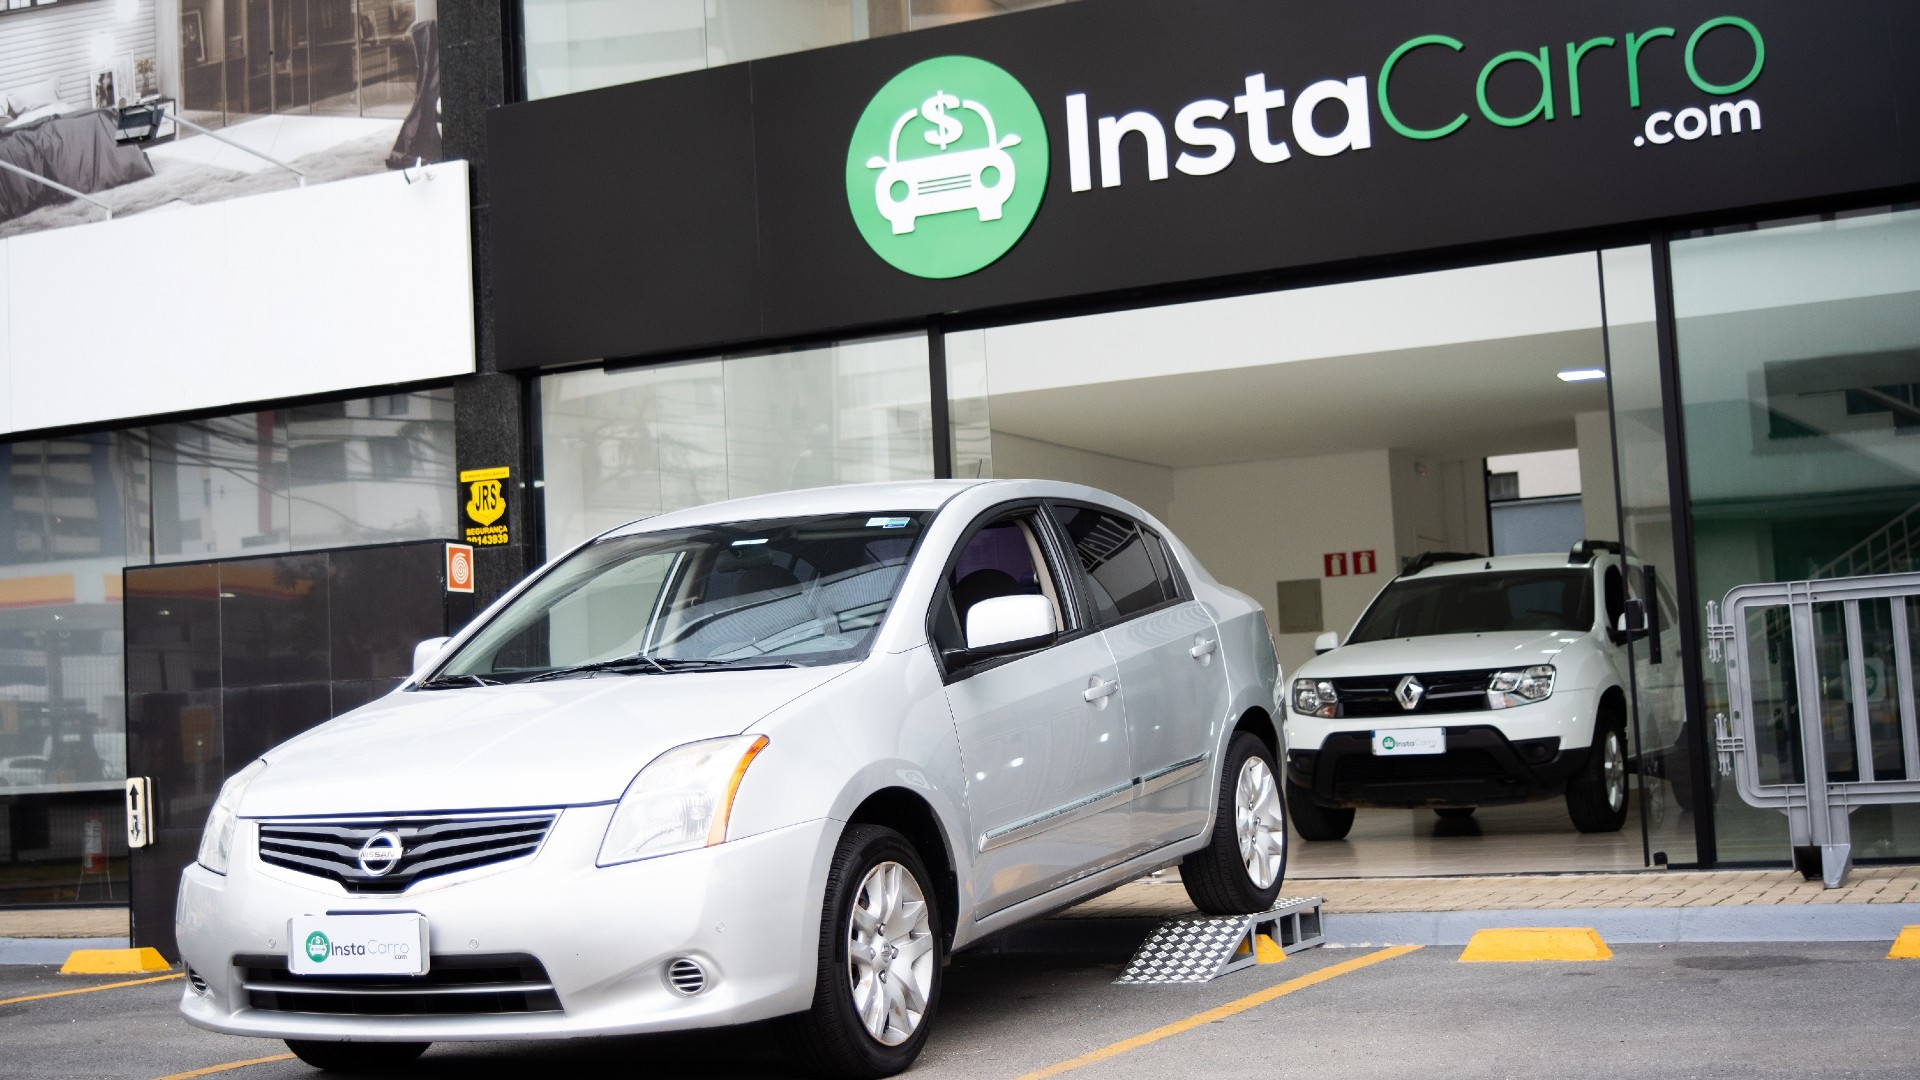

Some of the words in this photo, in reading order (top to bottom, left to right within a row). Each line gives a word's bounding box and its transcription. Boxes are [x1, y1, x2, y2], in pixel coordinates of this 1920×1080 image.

[1065, 15, 1766, 193] InstaCarro
[1633, 98, 1762, 148] .com
[476, 484, 497, 511] JRS
[466, 525, 508, 535] SEGURANÇA
[330, 939, 410, 956] InstaCarro
